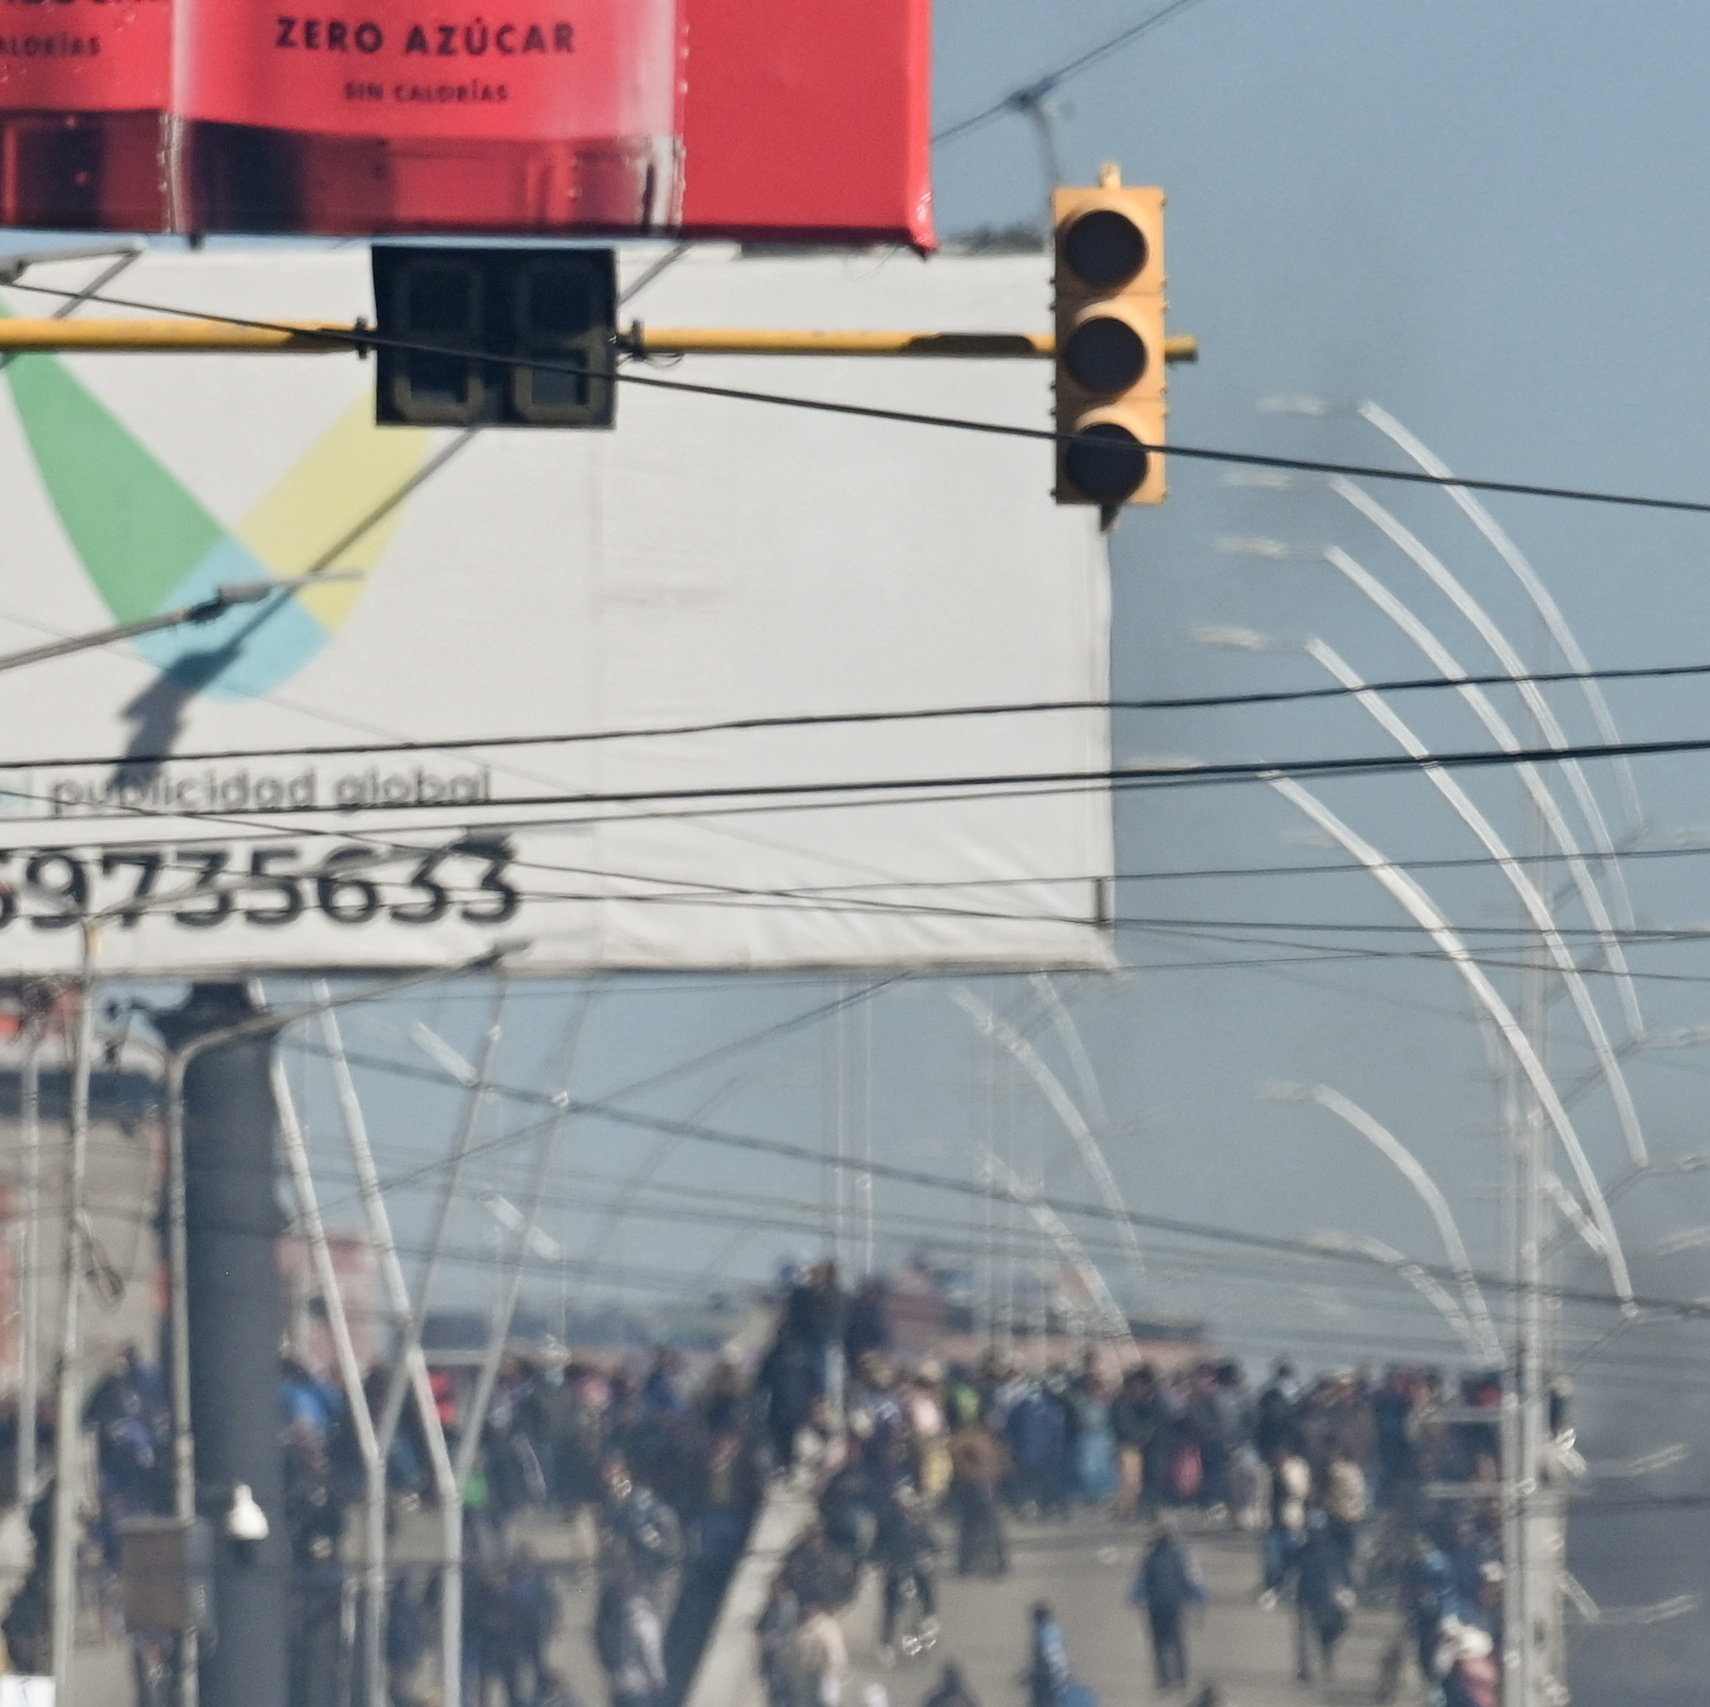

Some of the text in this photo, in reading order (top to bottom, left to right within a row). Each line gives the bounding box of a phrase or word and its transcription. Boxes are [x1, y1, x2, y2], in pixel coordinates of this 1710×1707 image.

[274, 16, 577, 56] ZERO AZÚCAR
[51, 765, 316, 818] publicidad
[334, 764, 490, 815] global
[0, 844, 522, 931] 9735633
